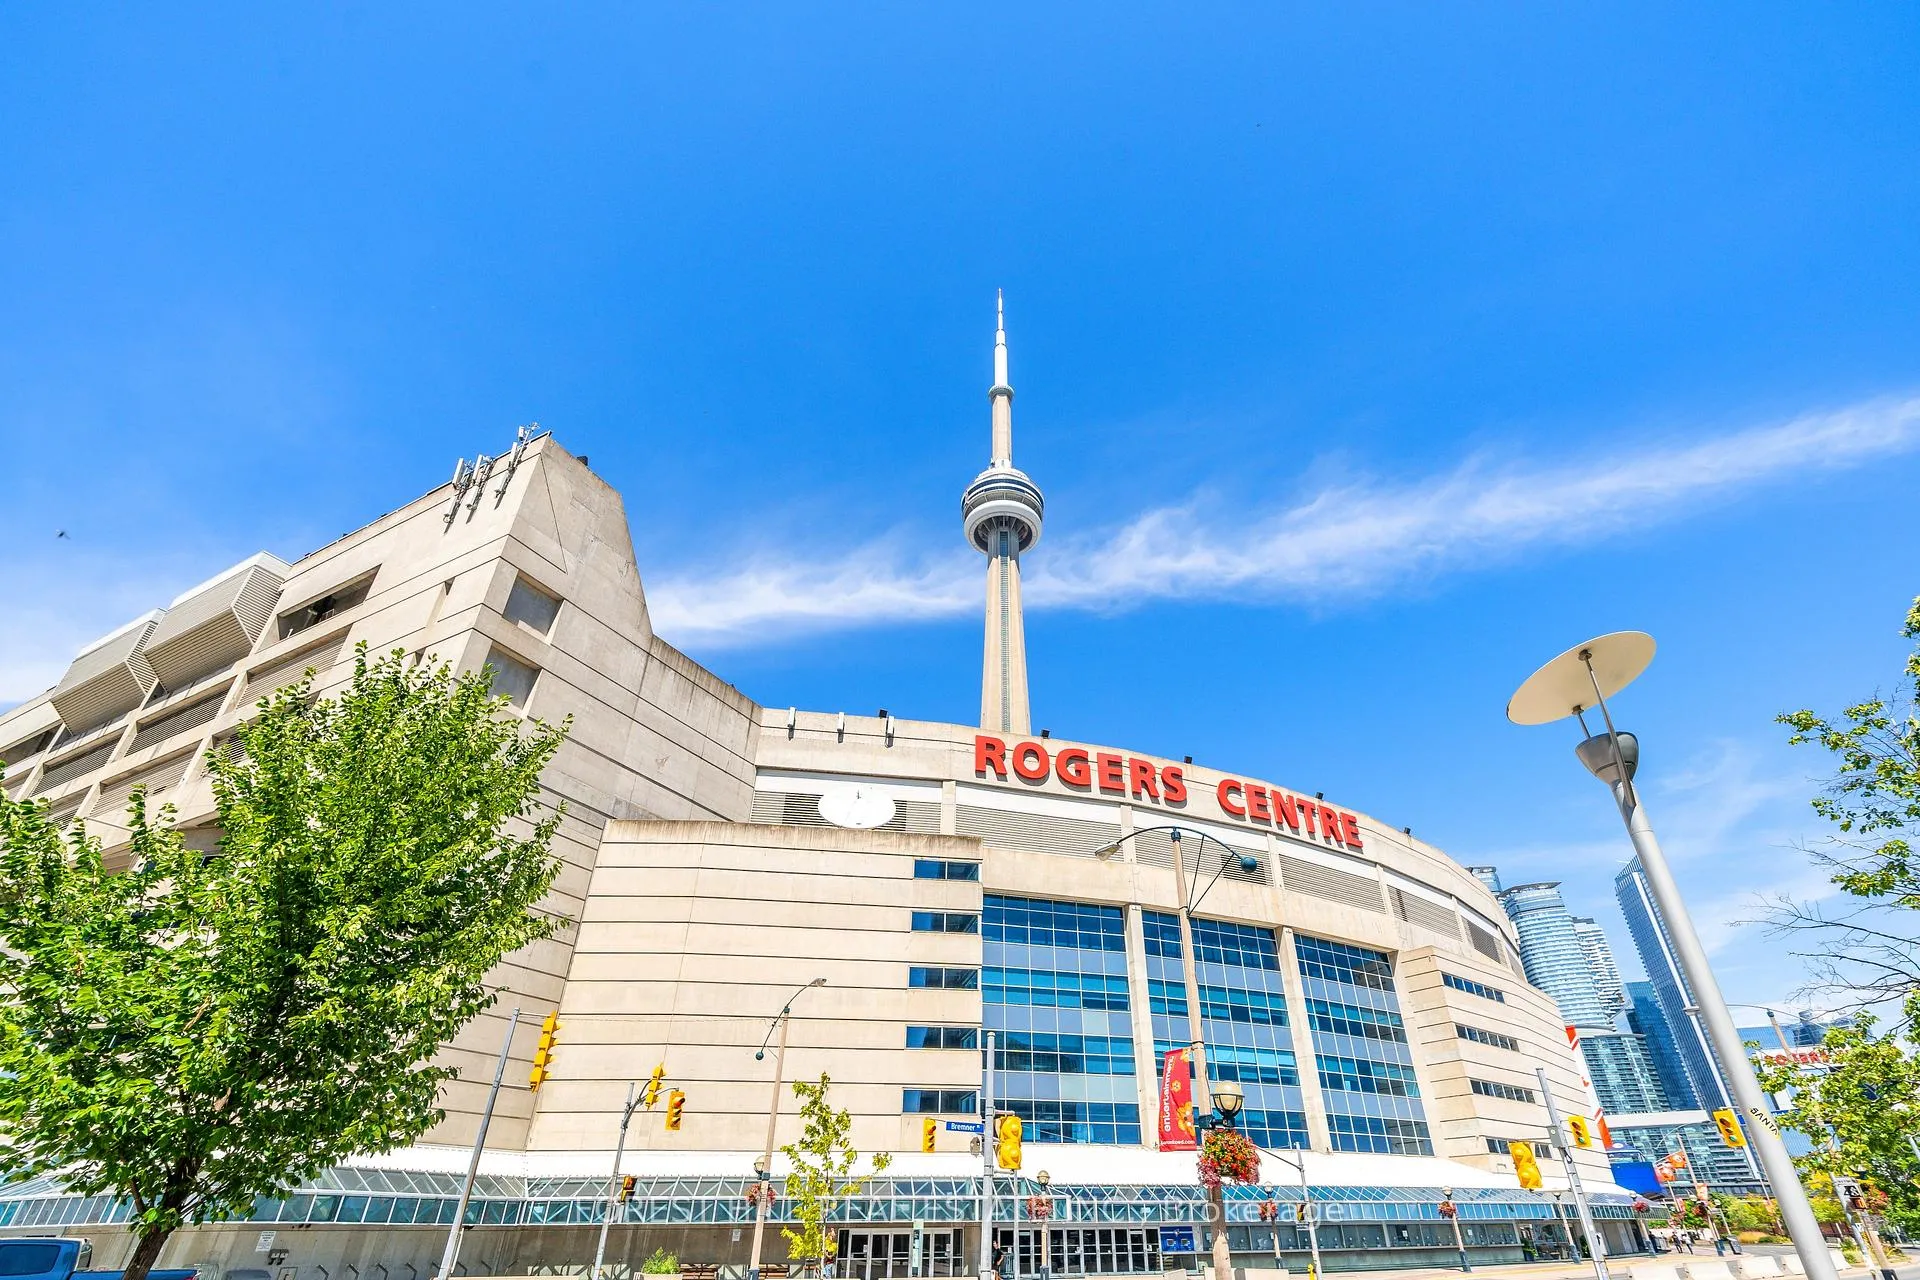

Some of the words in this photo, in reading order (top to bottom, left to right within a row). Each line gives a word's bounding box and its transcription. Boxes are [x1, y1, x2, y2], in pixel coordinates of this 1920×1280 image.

[975, 734, 1187, 802] ROGERS
[1216, 779, 1363, 848] CENTRE
[1163, 1055, 1175, 1132] entertainment
[951, 1122, 976, 1131] Bremner
[1749, 1106, 1779, 1136] SANTA
